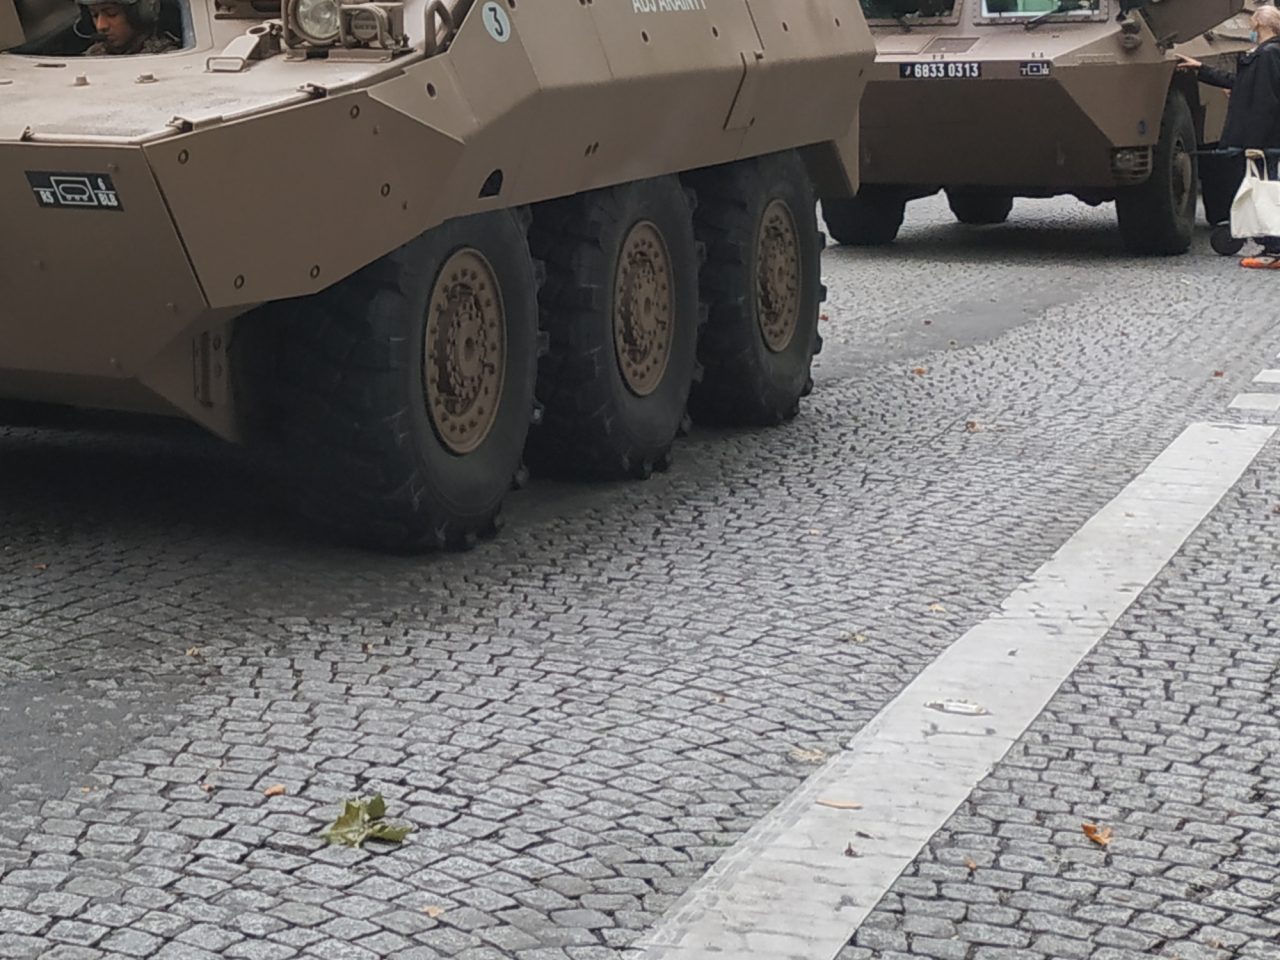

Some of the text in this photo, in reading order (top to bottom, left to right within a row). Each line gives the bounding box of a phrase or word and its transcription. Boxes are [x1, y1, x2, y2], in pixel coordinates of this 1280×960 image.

[488, 7, 503, 36] 3
[914, 62, 979, 78] 6833 0313
